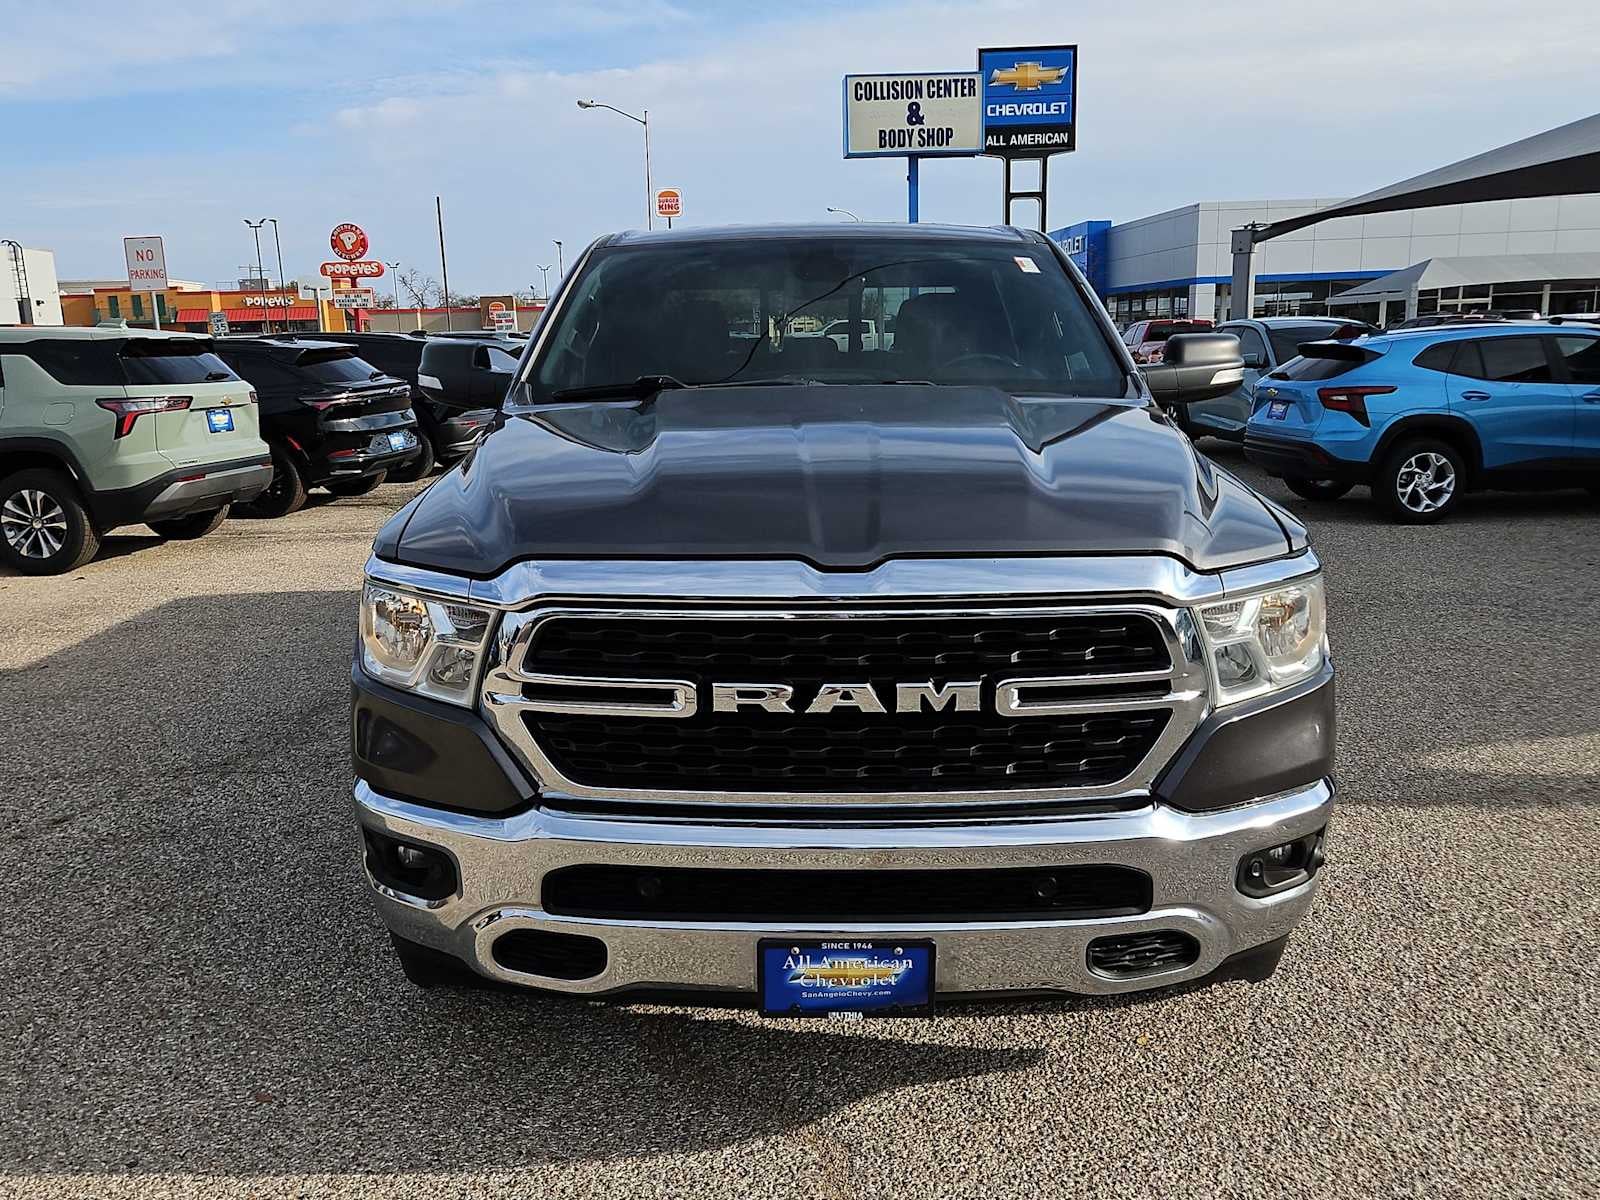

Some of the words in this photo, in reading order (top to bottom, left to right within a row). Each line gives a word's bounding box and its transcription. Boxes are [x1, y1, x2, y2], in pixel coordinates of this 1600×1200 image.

[854, 79, 923, 101] COLLISION
[926, 78, 977, 99] CENTER
[906, 101, 925, 126] &
[986, 101, 1068, 117] CHEVROLET
[878, 129, 917, 149] BODY
[917, 127, 954, 148] SHOP
[985, 134, 1006, 147] ALL
[1009, 132, 1069, 146] AMERICAN
[658, 203, 680, 211] KING
[136, 249, 154, 262] NO
[130, 268, 165, 280] PARKING
[214, 323, 227, 332] 35
[712, 681, 982, 714] RAM
[821, 942, 850, 950] SINCE
[853, 942, 873, 950] 1946
[782, 954, 811, 969] All
[820, 955, 913, 970] American
[800, 973, 897, 987] Chevrolet
[801, 990, 892, 999] SanAngeloChevy.com
